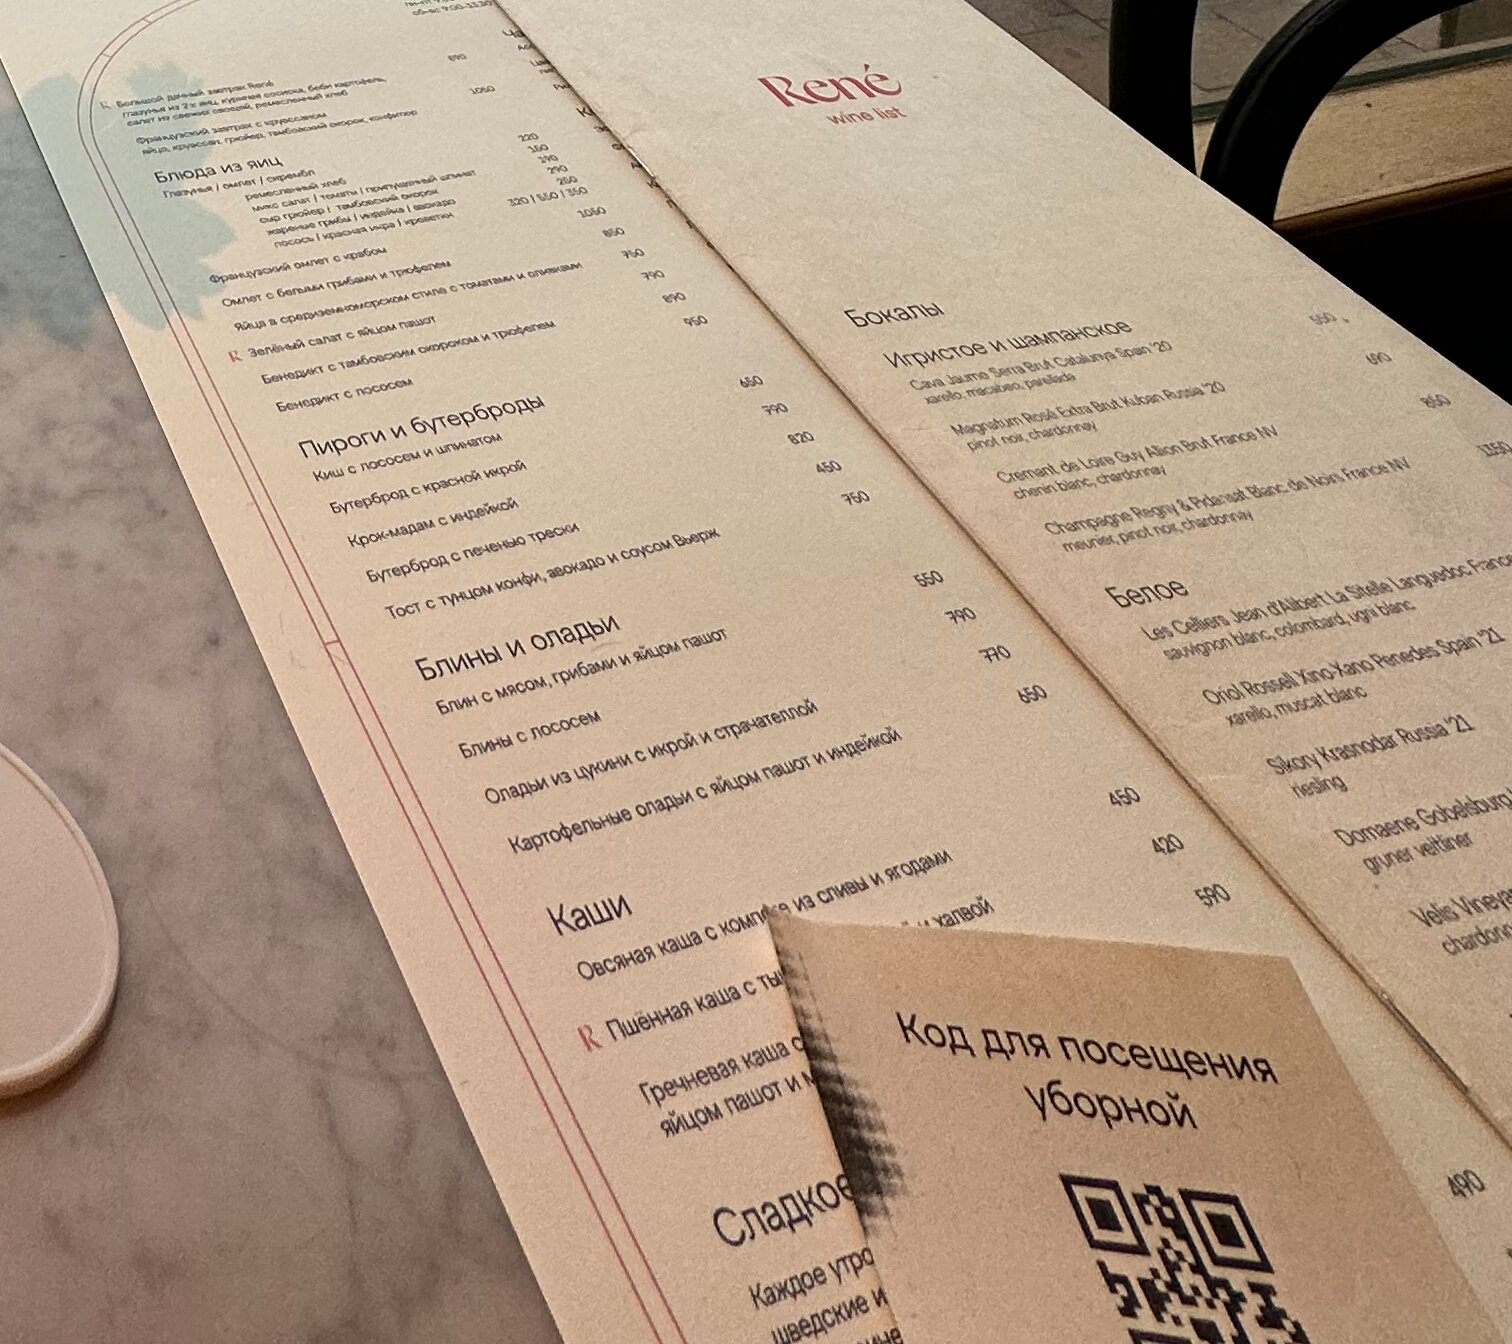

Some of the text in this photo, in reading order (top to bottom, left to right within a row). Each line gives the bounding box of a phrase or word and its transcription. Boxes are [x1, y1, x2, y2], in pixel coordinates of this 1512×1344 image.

[758, 64, 903, 108] René
[826, 106, 908, 125] wine list
[154, 157, 283, 183] Блюда из яиц
[843, 302, 945, 328] Бокалы
[883, 322, 1133, 369] Игристое и шампанское
[298, 396, 545, 459] Пироги и бутерброды
[761, 403, 788, 416] 790
[787, 431, 815, 445] 820
[329, 459, 527, 516] Бутерброд с красной икрой
[816, 460, 842, 473] 450
[841, 490, 870, 506] 750
[347, 497, 519, 548] Крок-мадам с индейкой
[366, 523, 580, 583] Бутерброд с печенью трески
[384, 528, 721, 619] Тост с тунцом конфи, авокадо и соусом Вьерж
[912, 570, 944, 587] 550
[1104, 581, 1189, 608] Белое
[944, 607, 976, 624] 790
[414, 615, 621, 681] Блины и оладьи
[978, 645, 1011, 663] 770
[435, 628, 727, 715] Блин с мясом, грибами и яйцом пашот
[1016, 684, 1047, 704] 650
[458, 710, 602, 760] Блины с лососем
[485, 698, 818, 804] Оладьи из цукини с икрой и страчателлой
[1315, 733, 1399, 763] Krasnodar
[1395, 721, 1449, 745] Russia
[507, 726, 902, 856] Картофельные оладьи с яйцом пашот и индейкой
[1108, 787, 1140, 807] 450
[1290, 775, 1348, 799] riesling
[1152, 833, 1184, 856] 420
[546, 894, 633, 937] Каши
[577, 944, 656, 981] Овсяная
[658, 930, 703, 957] каша
[704, 925, 719, 942] с
[792, 895, 816, 912] из
[816, 876, 870, 904] сливы
[869, 872, 885, 887] и
[884, 850, 953, 883] ягодами
[1193, 883, 1231, 910] 590
[605, 1001, 694, 1042] Пшённая
[693, 986, 743, 1013] каша
[743, 981, 757, 996] с
[895, 1011, 1279, 1085] Код для посещения
[638, 1036, 806, 1109] Гречневая каша с
[660, 1075, 802, 1139] яйцом пашот и
[1023, 1079, 1198, 1132] уборной
[1446, 1169, 1487, 1200] 490
[713, 1173, 854, 1247] Сладкое
[749, 1266, 827, 1310] Каждое
[771, 1295, 870, 1344] шведские
